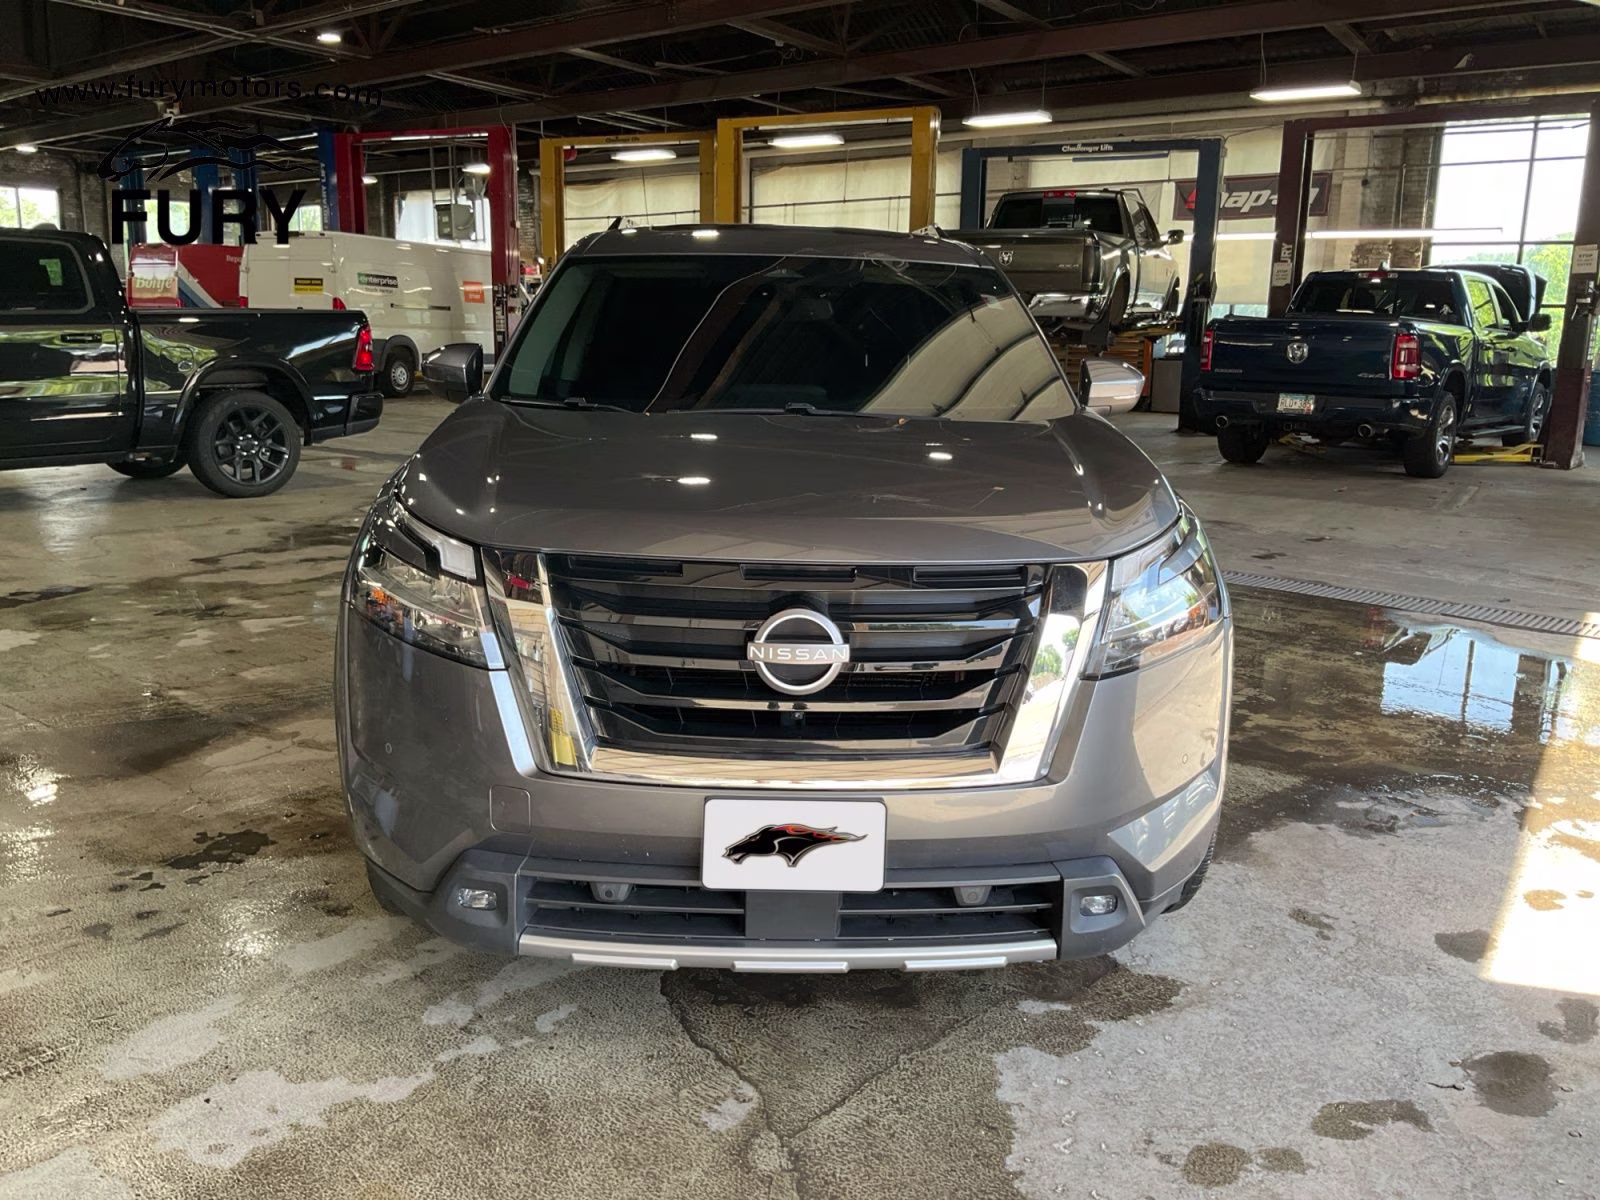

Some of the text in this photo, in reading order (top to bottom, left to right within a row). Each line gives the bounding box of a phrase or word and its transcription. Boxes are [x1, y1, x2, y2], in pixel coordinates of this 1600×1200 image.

[1061, 143, 1114, 152] Challenger Lifts
[749, 645, 847, 660] NISSAN
